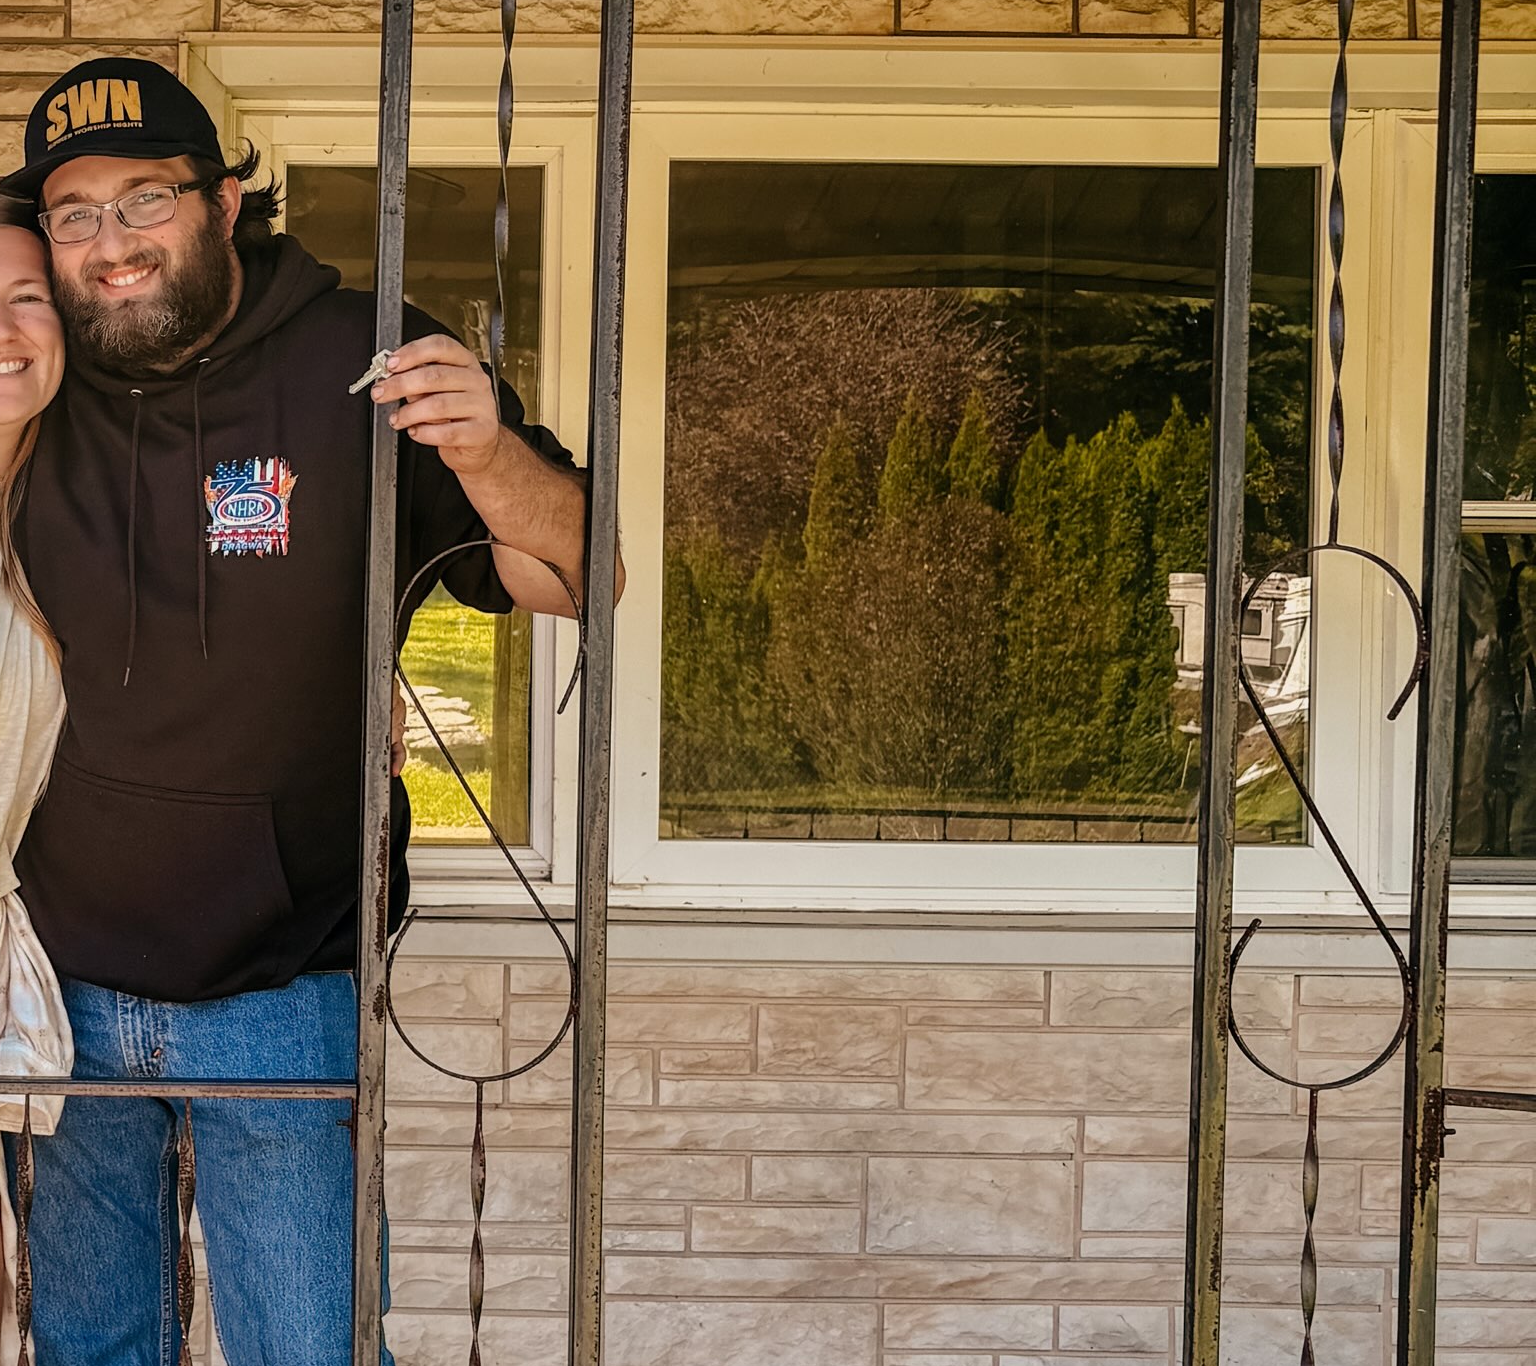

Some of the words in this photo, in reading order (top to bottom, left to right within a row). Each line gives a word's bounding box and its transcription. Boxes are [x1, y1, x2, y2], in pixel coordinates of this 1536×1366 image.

[46, 78, 142, 143] SWN
[210, 477, 282, 525] 75
[227, 500, 264, 516] NHRA
[221, 542, 268, 550] DRAGWAY
